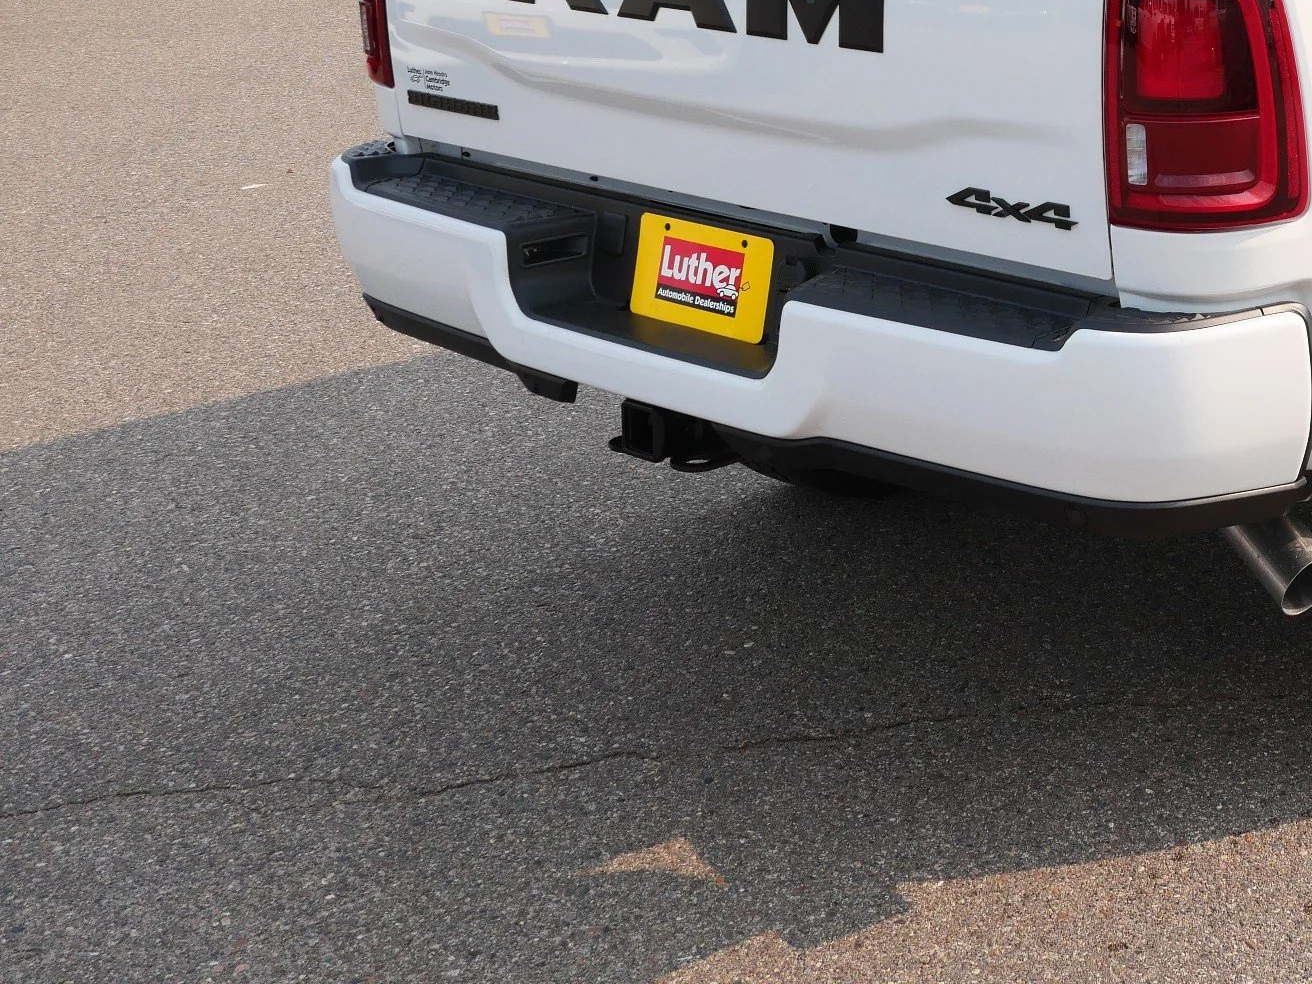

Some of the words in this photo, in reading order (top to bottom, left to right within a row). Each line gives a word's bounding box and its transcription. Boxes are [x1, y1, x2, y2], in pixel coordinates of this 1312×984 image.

[660, 244, 742, 291] Luther
[656, 286, 695, 304] Automobile
[694, 294, 735, 314] Dealerships
